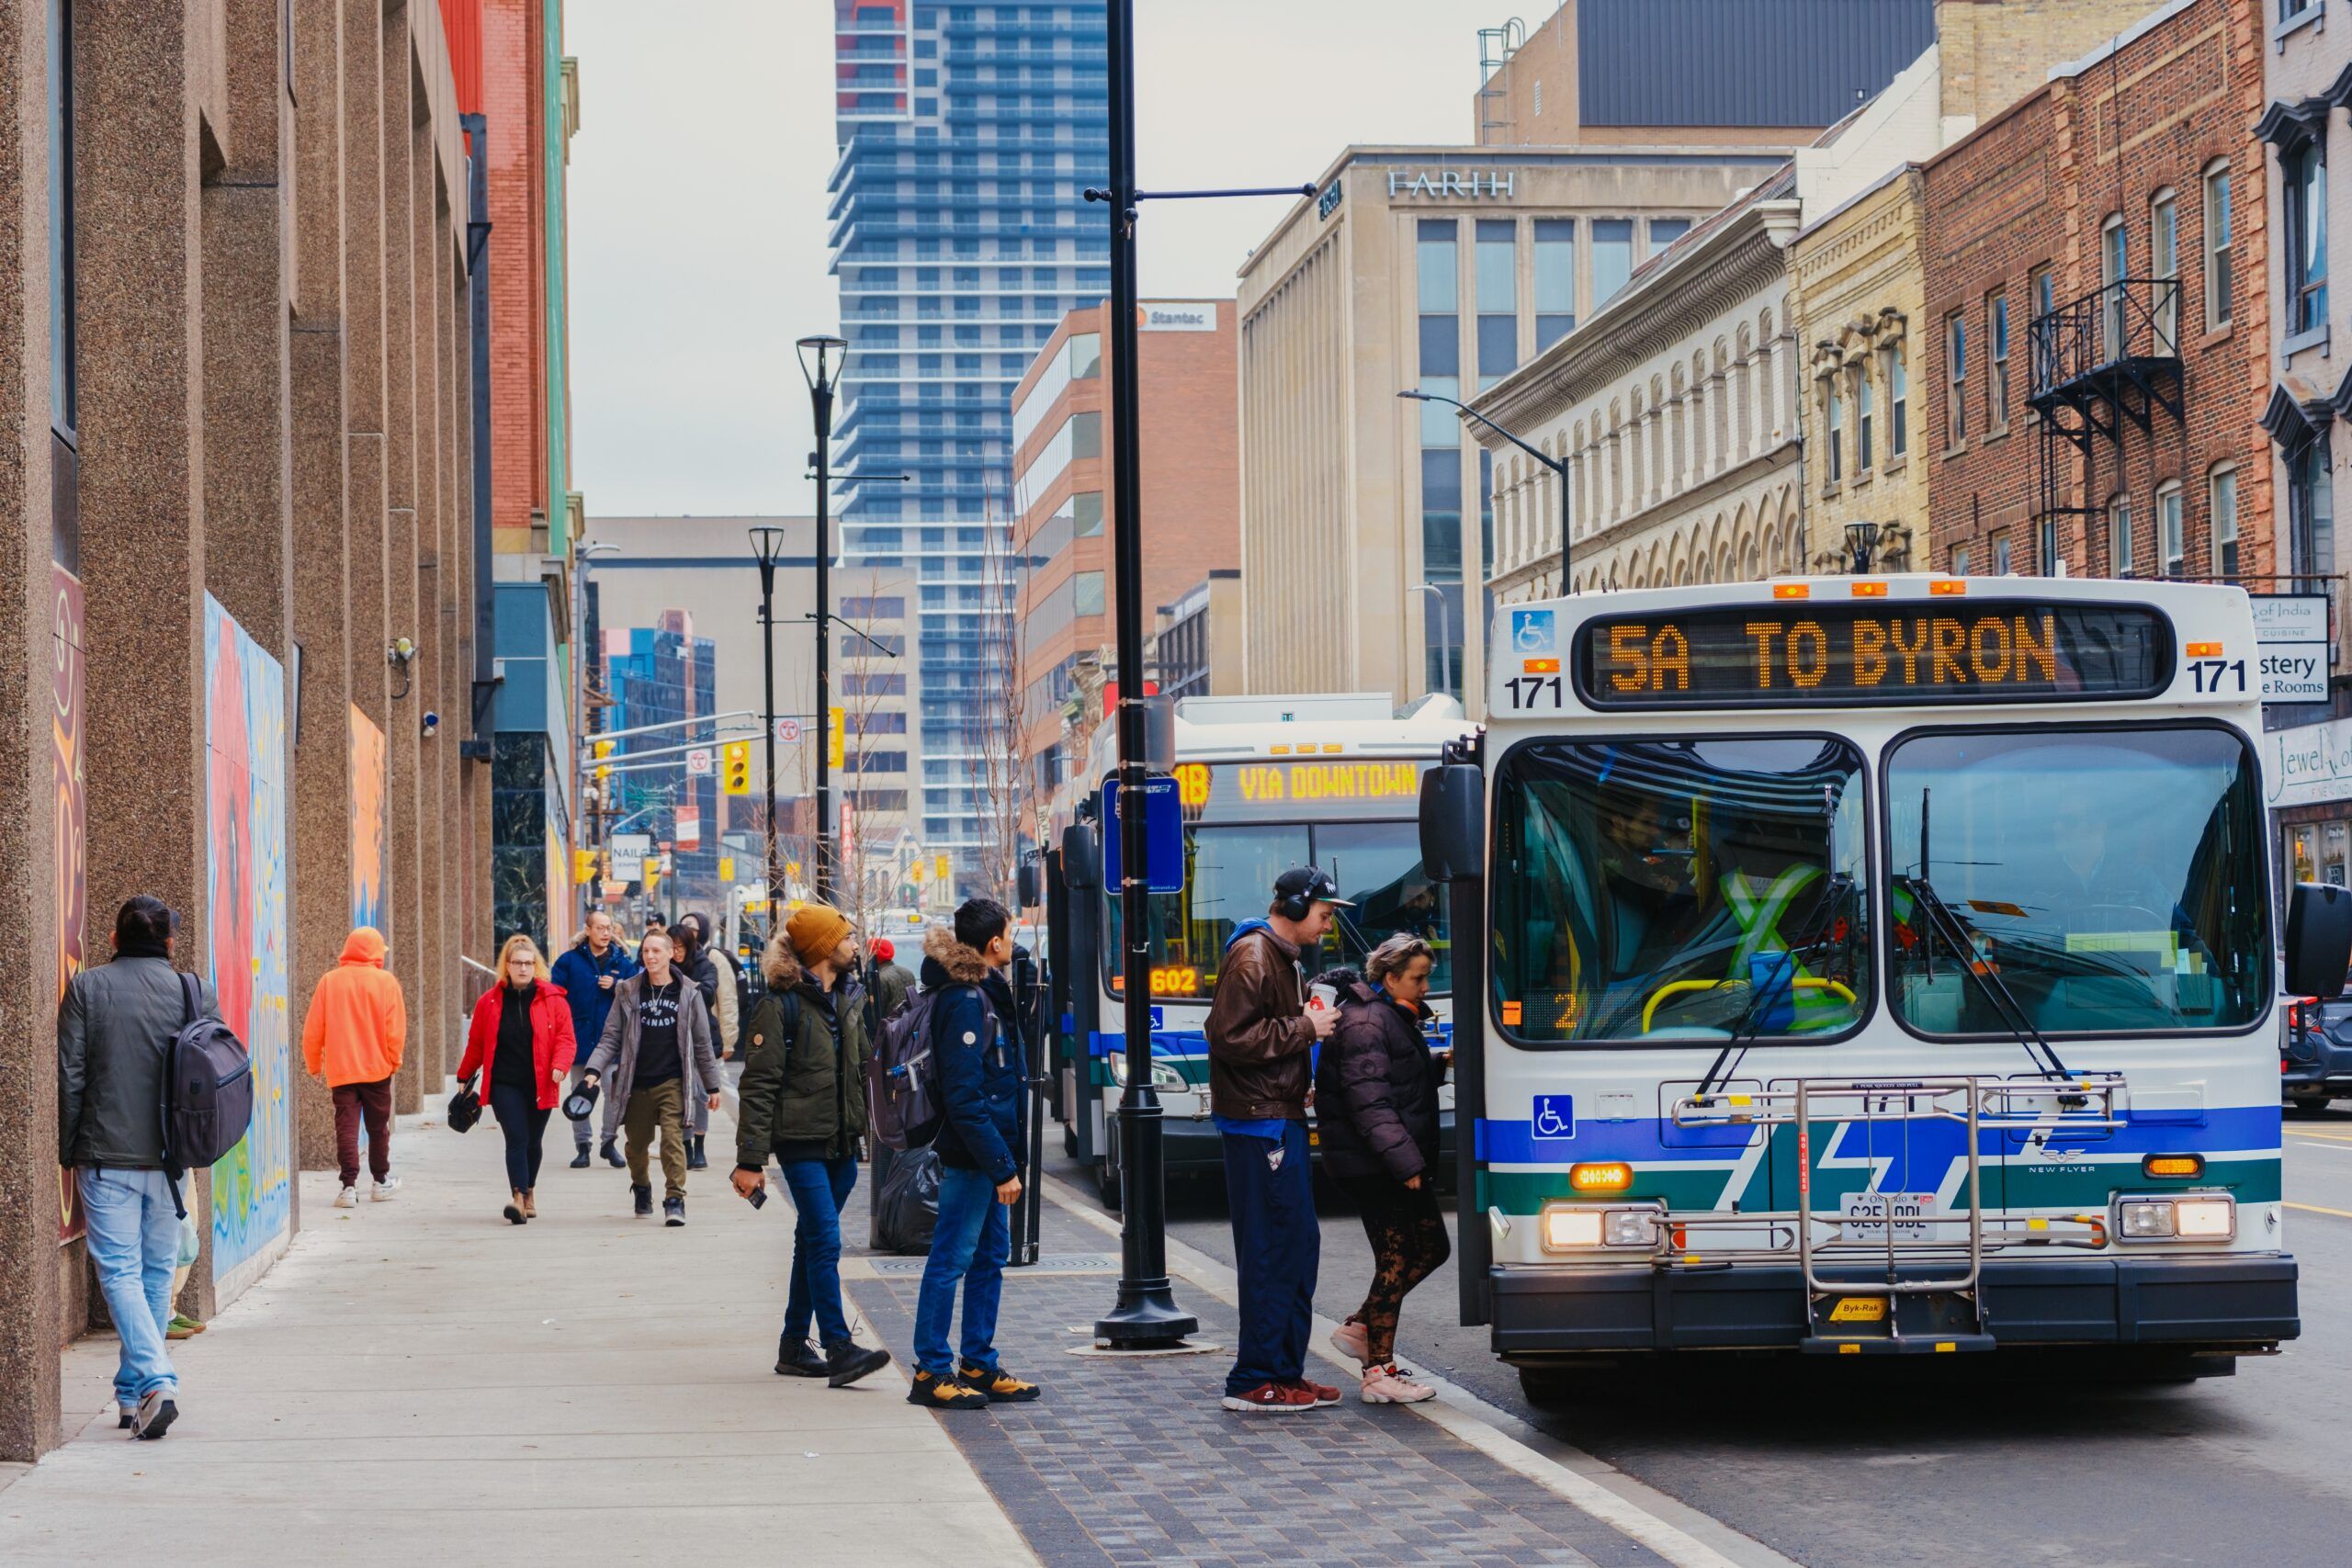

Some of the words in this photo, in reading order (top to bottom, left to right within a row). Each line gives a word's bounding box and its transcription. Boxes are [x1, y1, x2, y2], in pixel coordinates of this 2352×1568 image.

[1388, 172, 1515, 197] FARHI
[1151, 311, 1204, 324] Stantec
[2278, 602, 2312, 617] India
[1611, 625, 1689, 691] 5A
[1746, 621, 1827, 689] TO
[1853, 615, 2056, 686] BYRON
[2187, 660, 2245, 693] 171
[2274, 681, 2324, 694] Rooms
[1504, 677, 1562, 709] 171
[1239, 768, 1284, 800] VIA
[1290, 764, 1417, 799] DOWNTOWN
[1151, 968, 1196, 994] 602
[641, 1016, 676, 1027] CANADA
[1843, 1303, 1879, 1314] Byk-Rak
